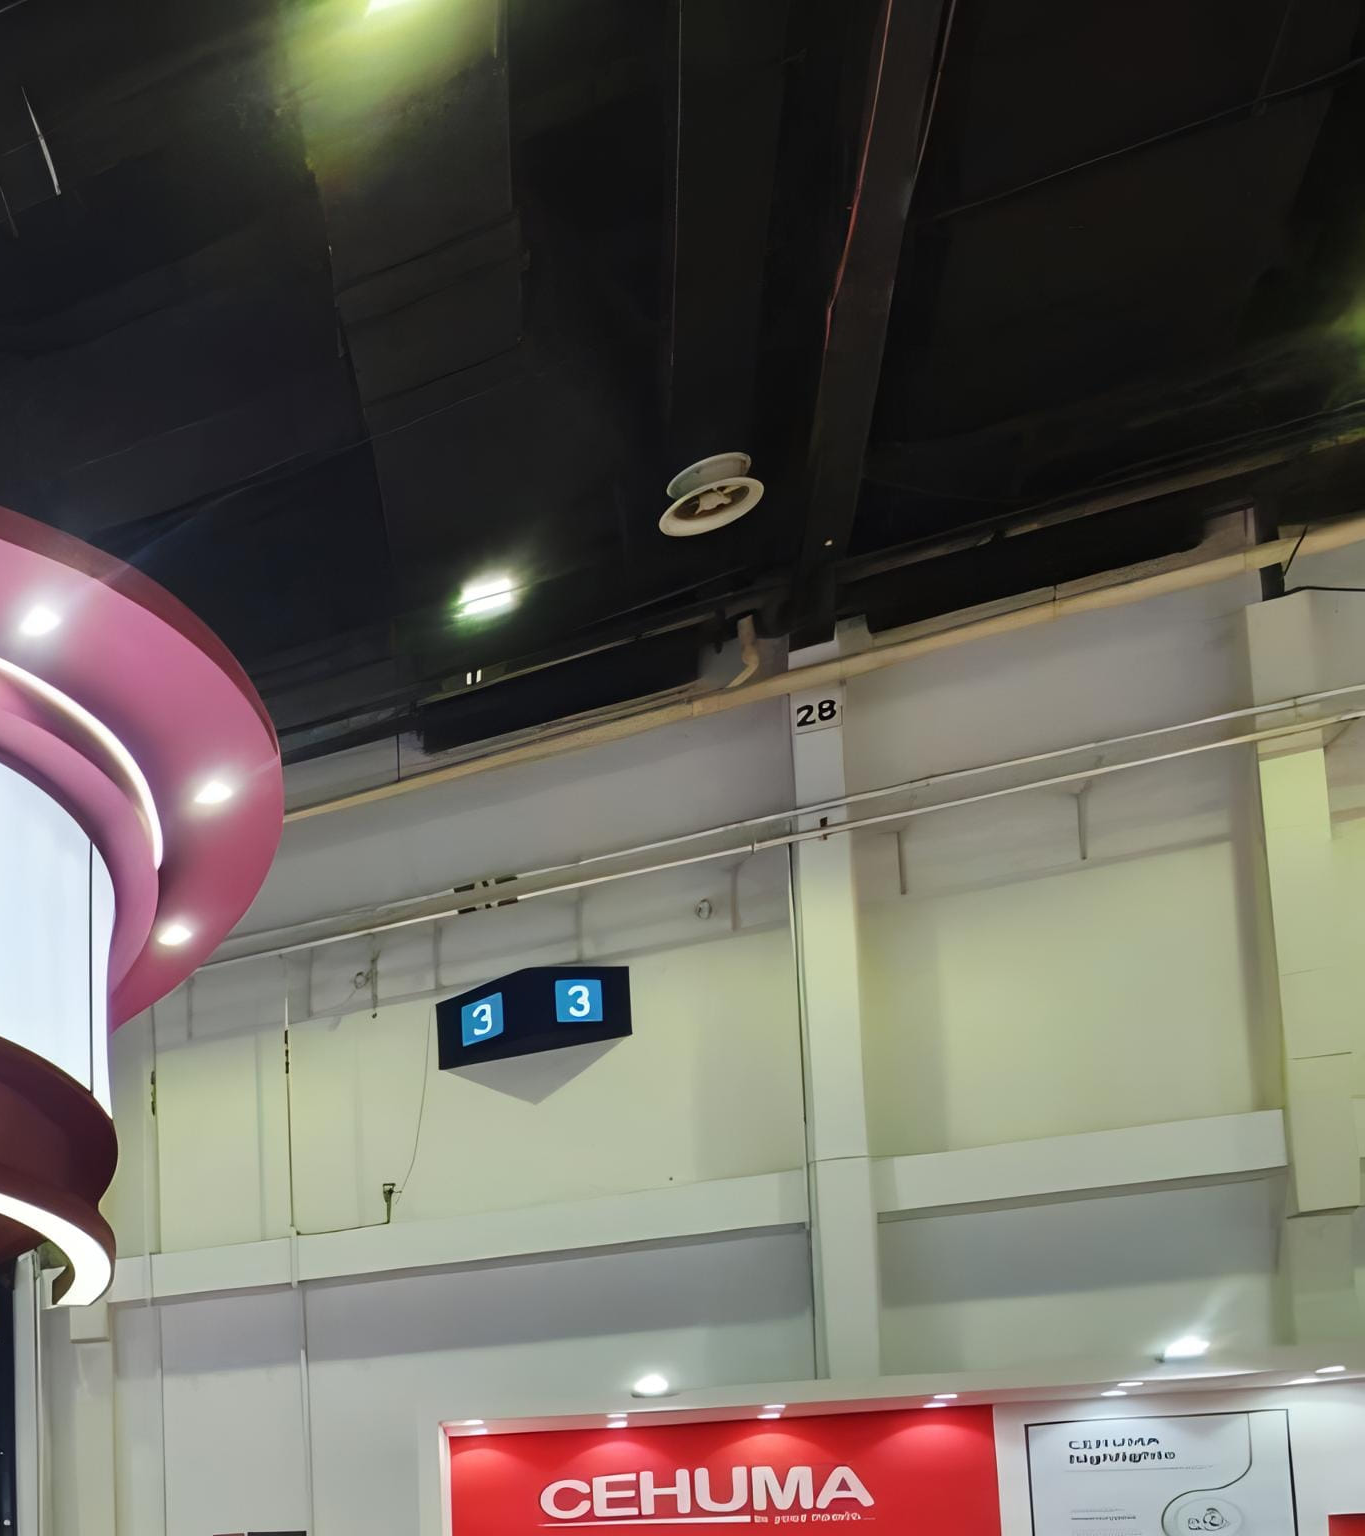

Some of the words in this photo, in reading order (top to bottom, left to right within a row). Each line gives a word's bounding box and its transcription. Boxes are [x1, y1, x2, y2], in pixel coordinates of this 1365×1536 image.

[797, 699, 837, 728] 28
[567, 984, 591, 1018] 3
[472, 1003, 493, 1036] 3
[539, 1464, 875, 1520] CEHUMA
